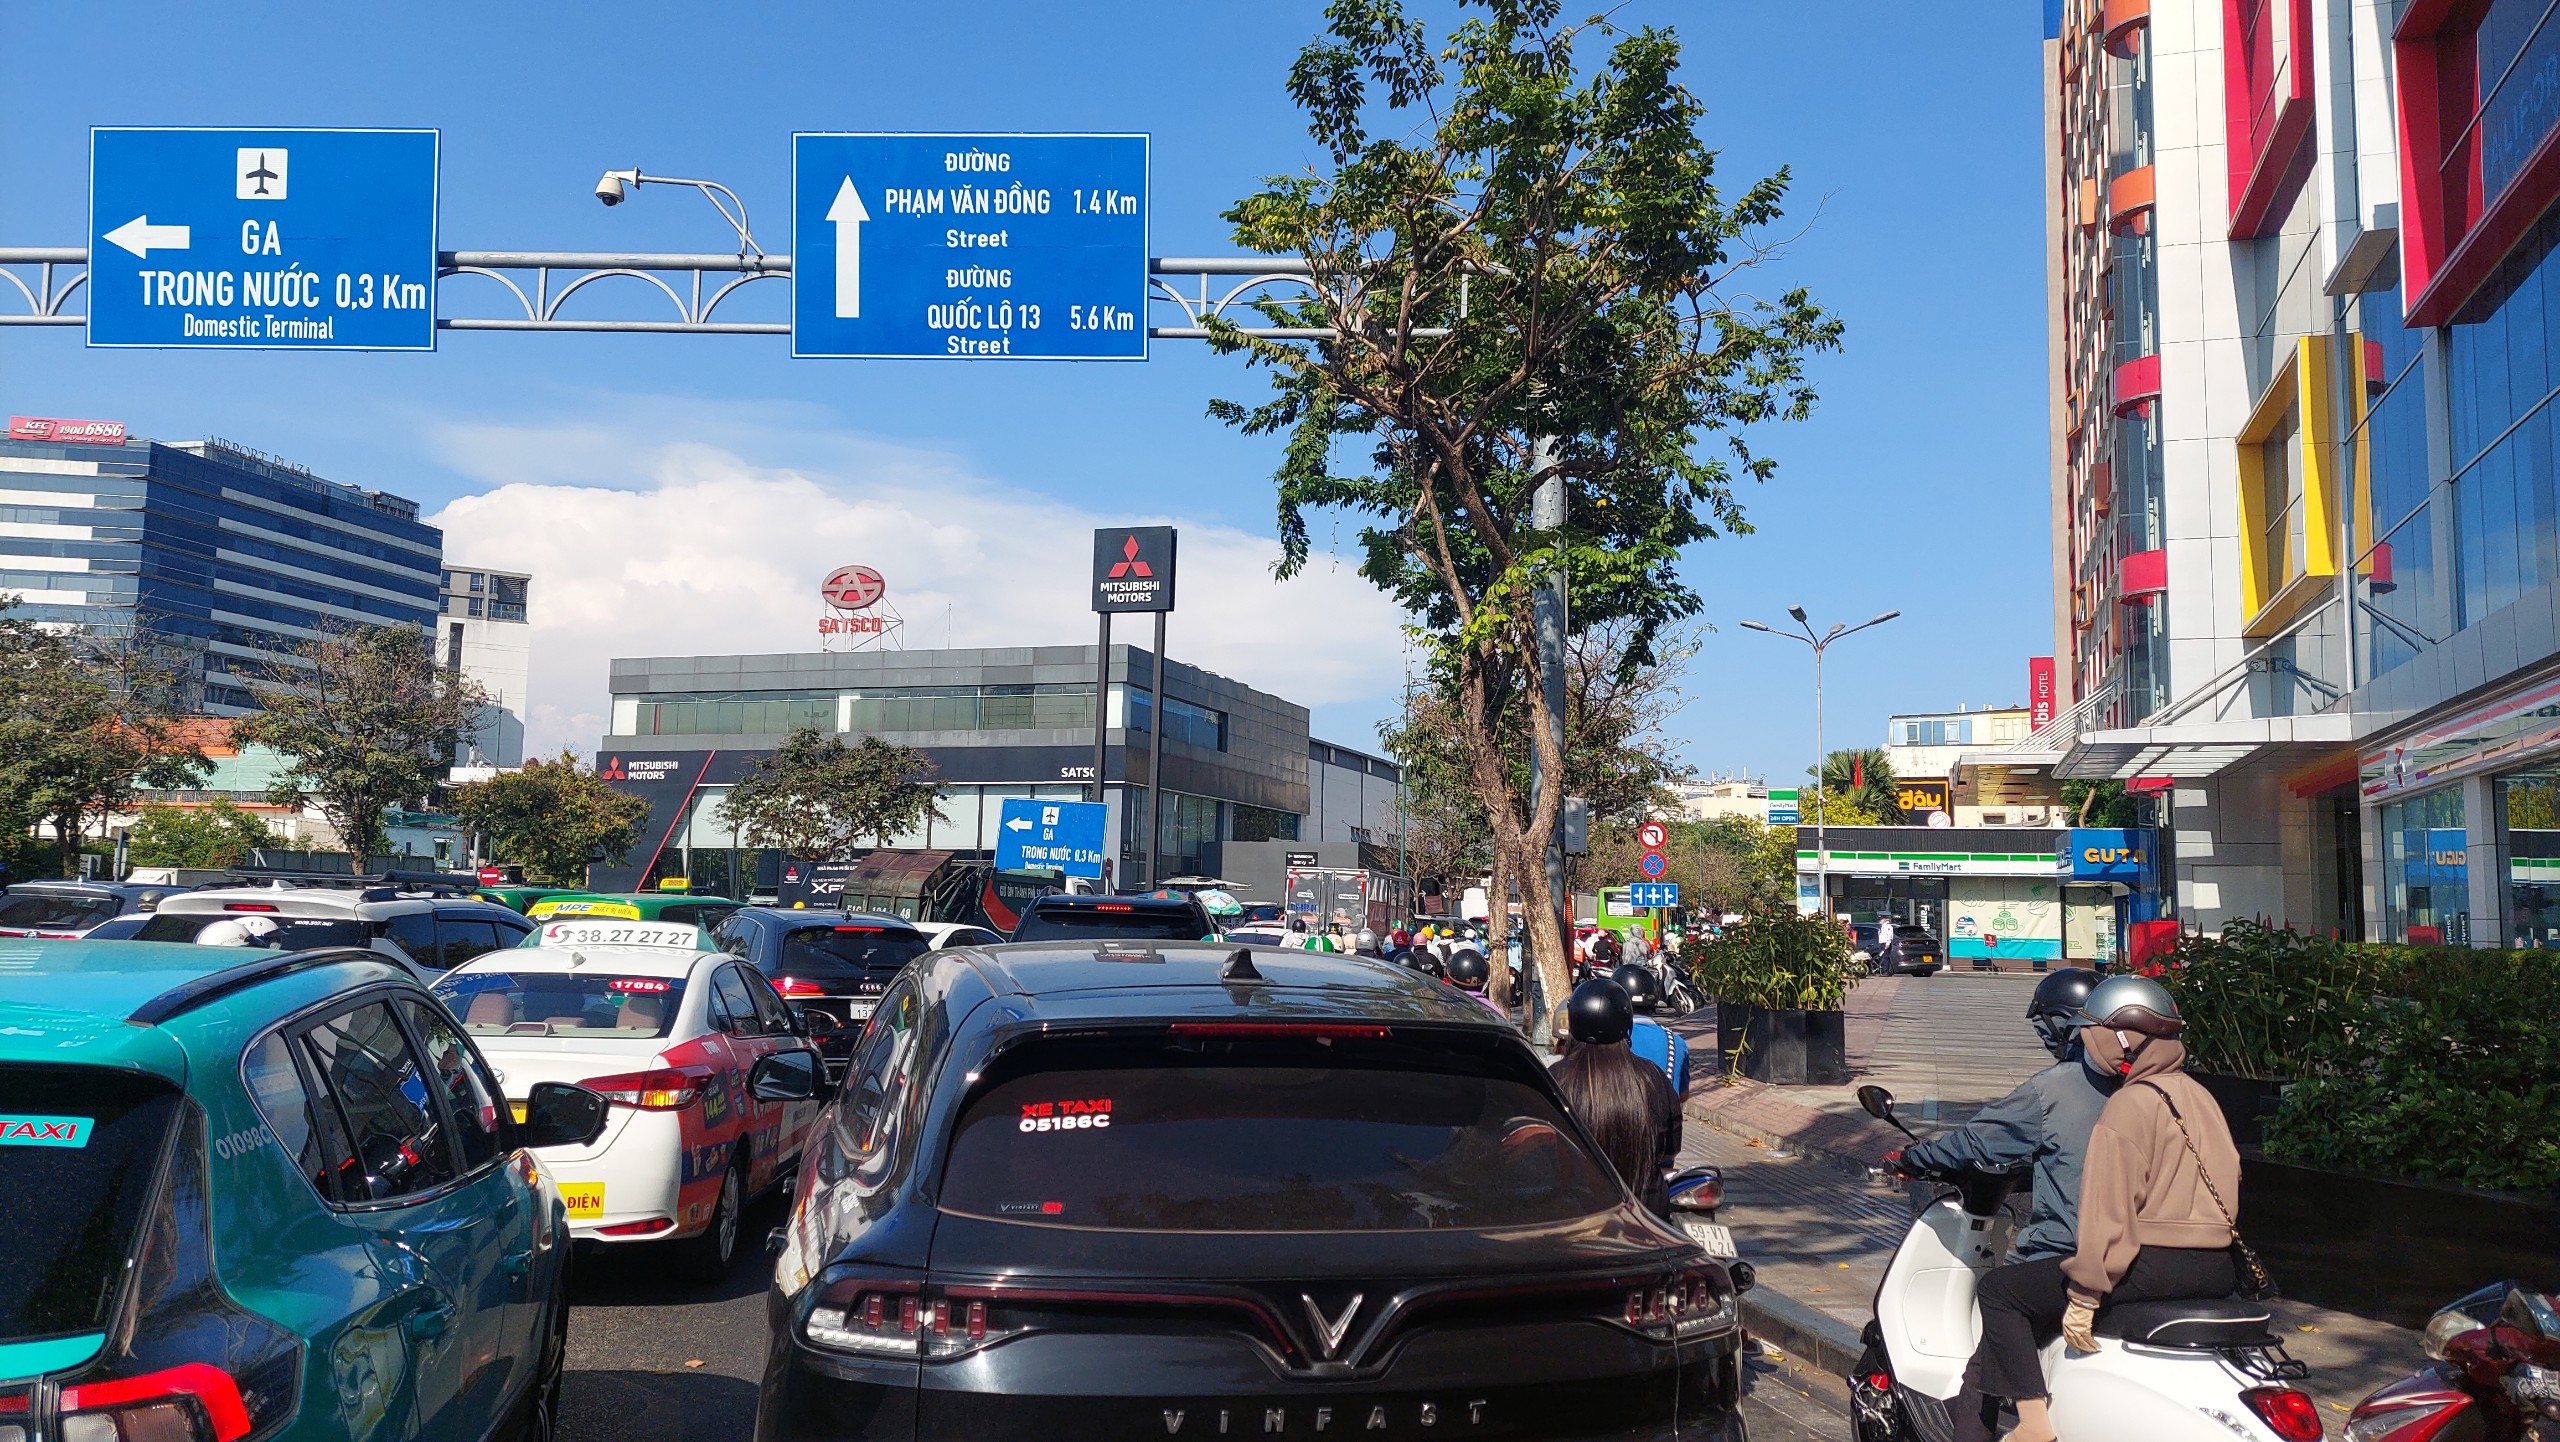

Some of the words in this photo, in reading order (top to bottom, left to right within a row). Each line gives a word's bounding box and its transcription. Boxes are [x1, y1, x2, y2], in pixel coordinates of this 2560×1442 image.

[944, 147, 1011, 173] ĐƯỜNG
[885, 189, 944, 219] PHẠM
[950, 183, 989, 215] VĂN
[993, 181, 1051, 215] ĐỒNG
[1073, 190, 1101, 215] 1.4
[1106, 189, 1137, 215] Km
[241, 219, 282, 256] GA
[946, 229, 1009, 249] Street
[945, 264, 1012, 289] ĐƯỜNG
[139, 270, 234, 307] TRONG
[243, 262, 320, 308] NƯỚC
[383, 274, 426, 310] Km
[927, 296, 982, 331] QUỐC
[988, 299, 1012, 335] LỘ
[1018, 304, 1041, 330] 13
[1070, 305, 1100, 331] 5.6
[1103, 306, 1135, 331] Km
[184, 313, 261, 338] Domestic
[264, 314, 335, 340] Terminal
[947, 336, 1011, 355] Street
[26, 421, 49, 430] KFC
[59, 425, 85, 435] 1900
[85, 423, 124, 437] 6886
[206, 434, 268, 465] AIRPORT
[272, 454, 312, 478] PLAZA
[1100, 581, 1160, 593] MITSUBISHI
[1107, 592, 1152, 603] MOTORS
[819, 618, 882, 633] SATSCO
[2038, 670, 2049, 699] HOTEL
[2033, 702, 2049, 725] ibis
[628, 761, 679, 771] MITSUBISHI
[628, 771, 665, 780] MOTORS
[1043, 828, 1054, 841] GA
[1021, 845, 1048, 859] TRONG
[1049, 845, 1072, 861] NƯỚC
[1088, 850, 1101, 864] Km
[2084, 848, 2147, 864] GUTA
[1913, 862, 1962, 872] FamilyMart
[811, 883, 845, 894] XF
[555, 904, 593, 912] MPE
[900, 908, 911, 919] 48
[576, 930, 634, 943] 38.27
[638, 931, 663, 944] 27
[667, 932, 692, 945] 27
[615, 980, 665, 991] 17084
[1022, 1103, 1053, 1117] XE
[1058, 1099, 1112, 1115] TAXI
[1020, 1115, 1110, 1132] 05186C
[567, 1193, 600, 1211] ĐIỆN
[1689, 1224, 1725, 1241] 59-V1
[1164, 1400, 1487, 1434] VINFAST
